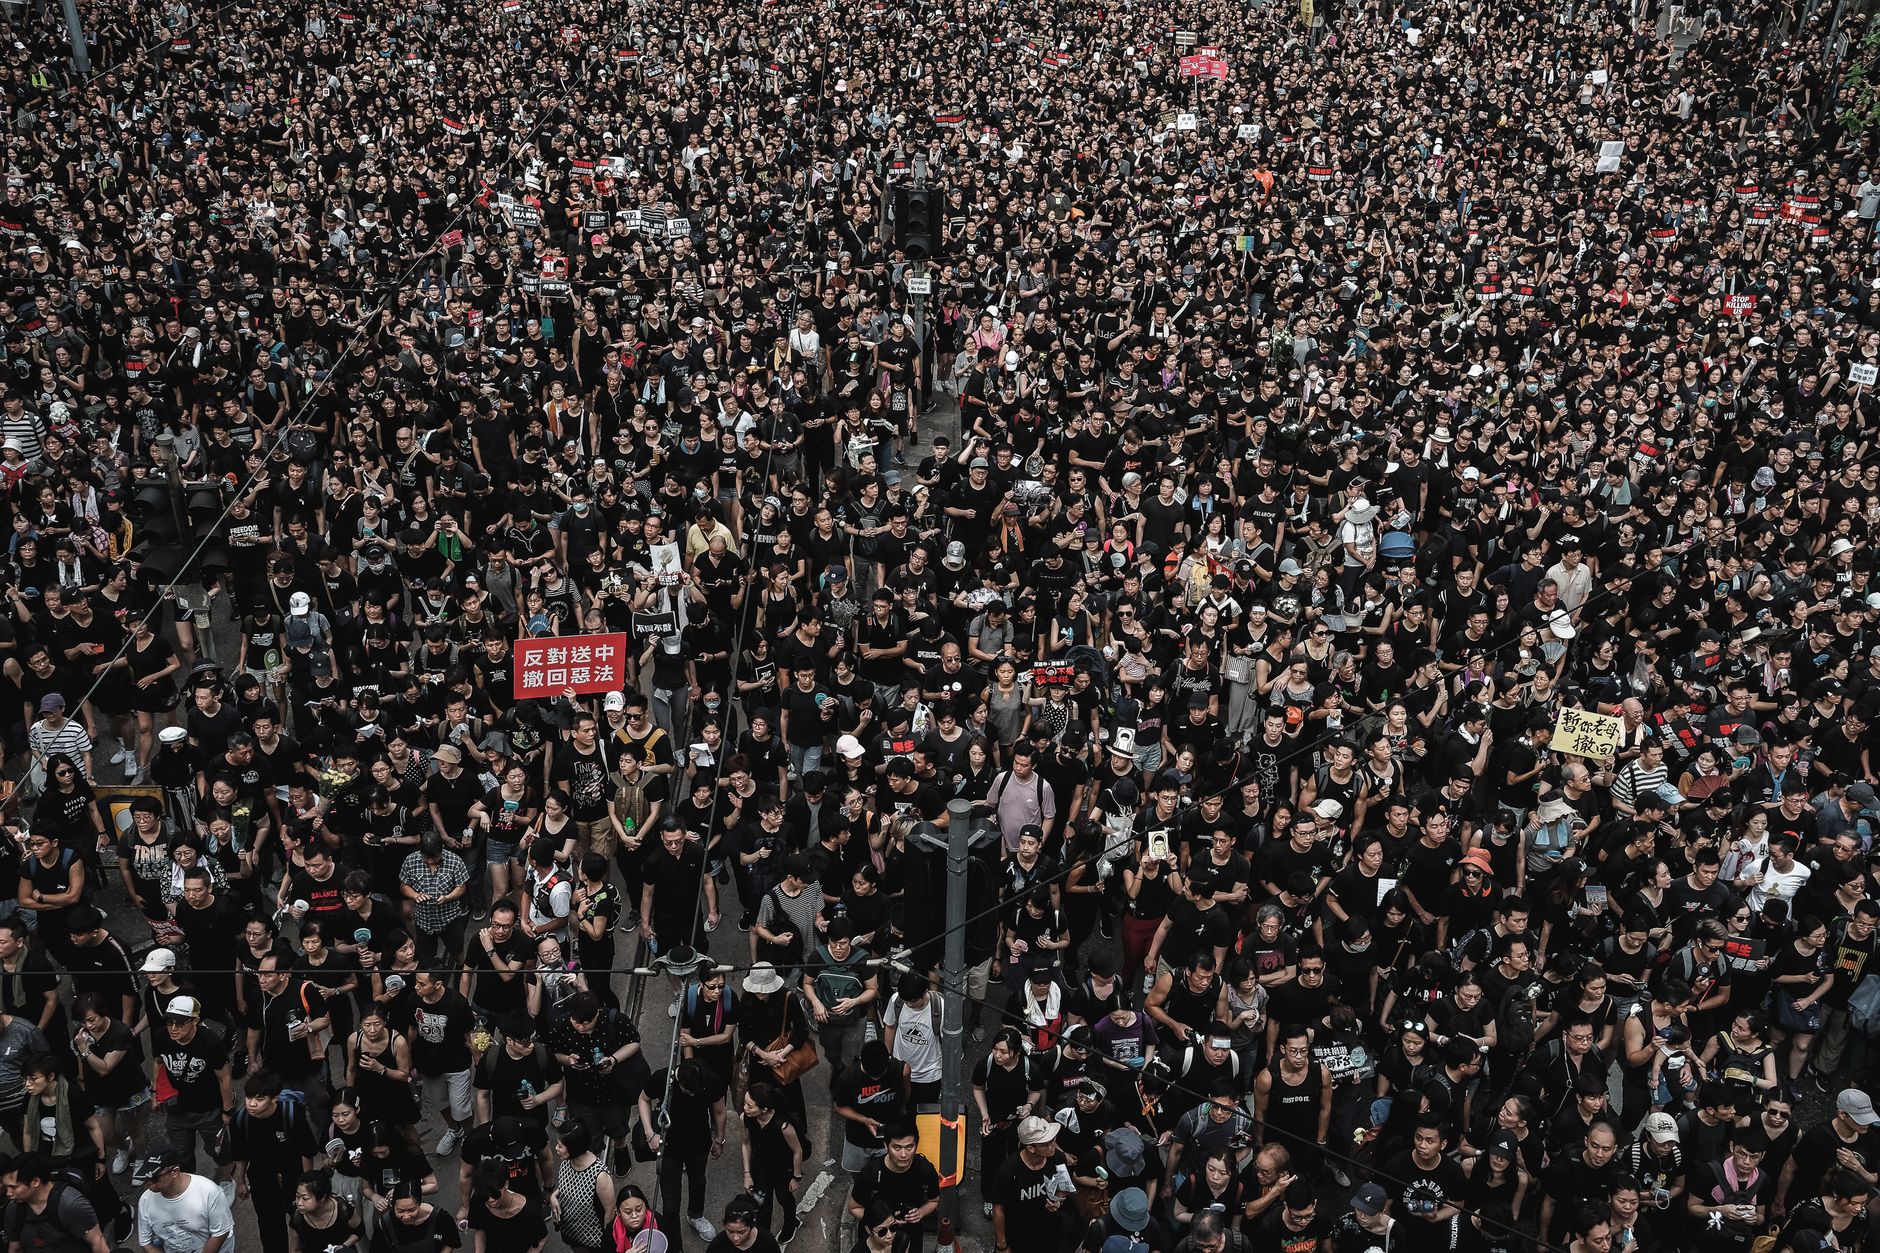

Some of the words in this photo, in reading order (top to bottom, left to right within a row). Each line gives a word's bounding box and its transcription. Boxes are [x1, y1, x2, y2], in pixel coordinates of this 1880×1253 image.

[230, 525, 259, 535] FREEDOM
[636, 623, 662, 633] 不撤不散
[523, 644, 615, 667] 反對送中
[523, 665, 615, 688] 撤回惡法
[1561, 709, 1620, 740] 暫你老母
[1572, 734, 1614, 755] 撤回
[574, 761, 592, 775] FIND
[135, 844, 168, 863] TRUE
[311, 889, 337, 899] BALANCE
[861, 1085, 881, 1098] JUST
[1020, 1182, 1045, 1201] NIK
